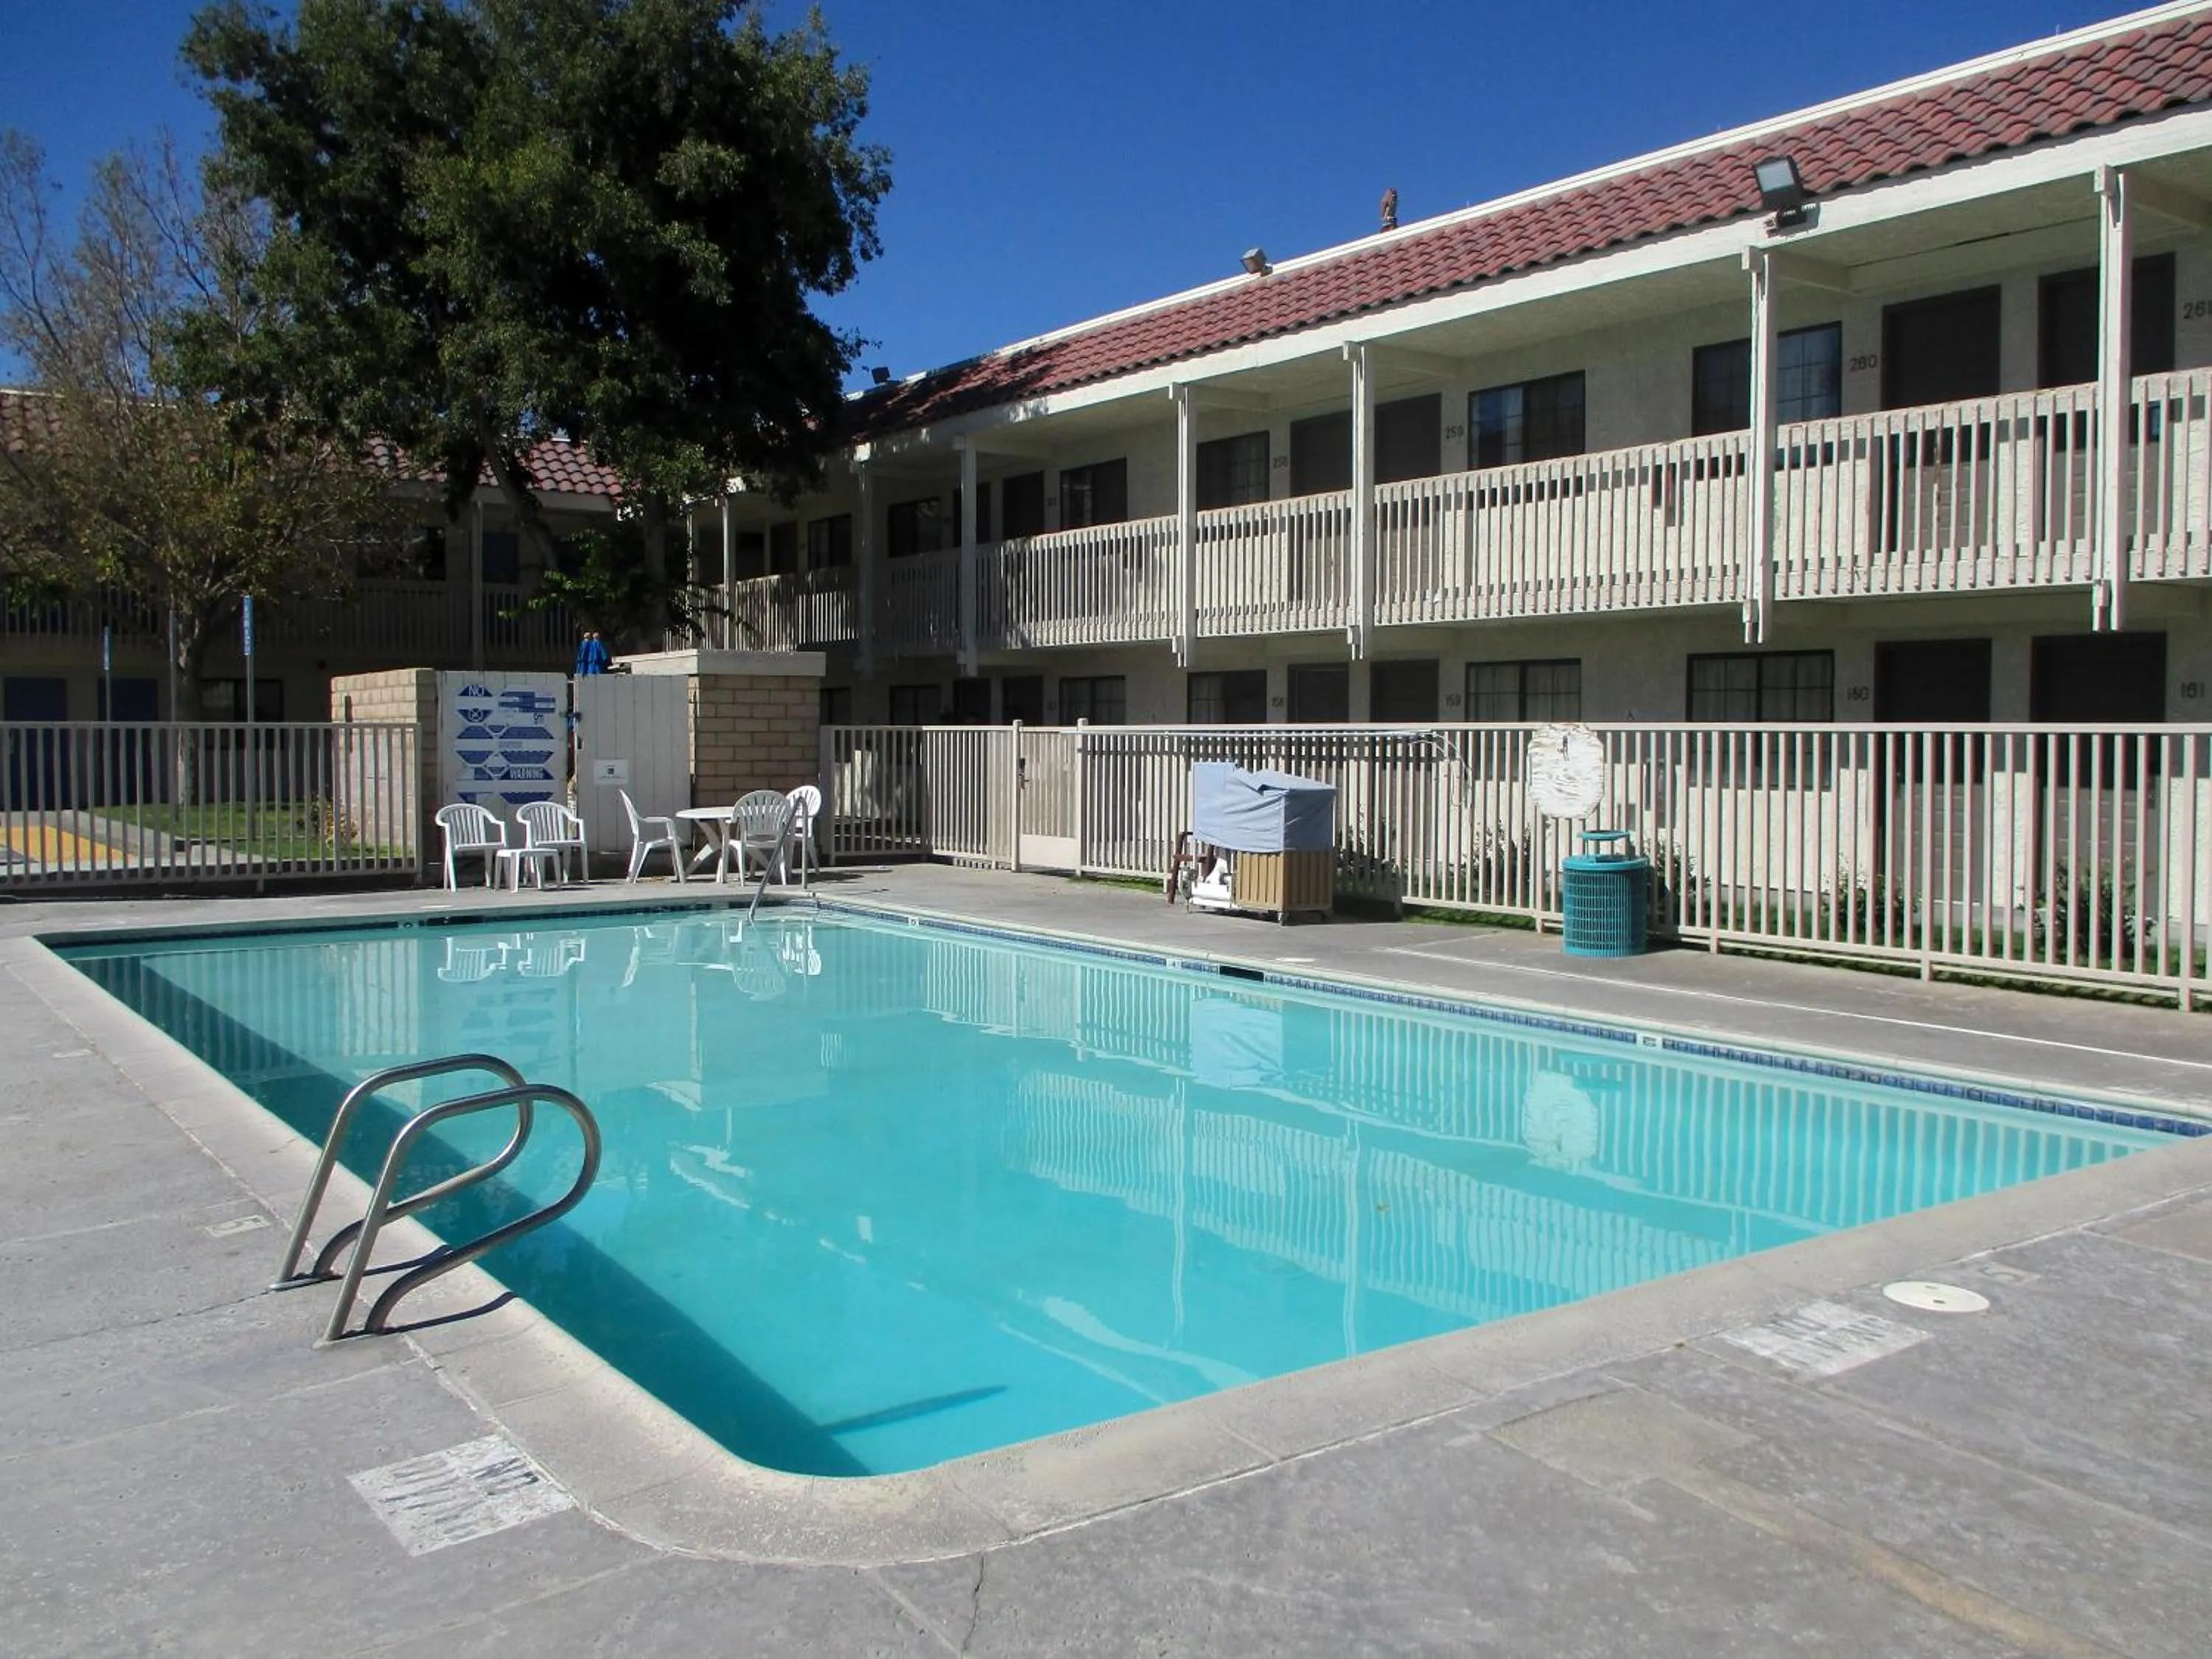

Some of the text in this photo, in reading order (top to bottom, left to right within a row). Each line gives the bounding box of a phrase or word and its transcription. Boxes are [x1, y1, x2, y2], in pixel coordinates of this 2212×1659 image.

[1849, 355, 1877, 372] 260
[469, 684, 484, 697] NO
[2182, 681, 2205, 699] 161
[510, 768, 543, 779] WARNING
